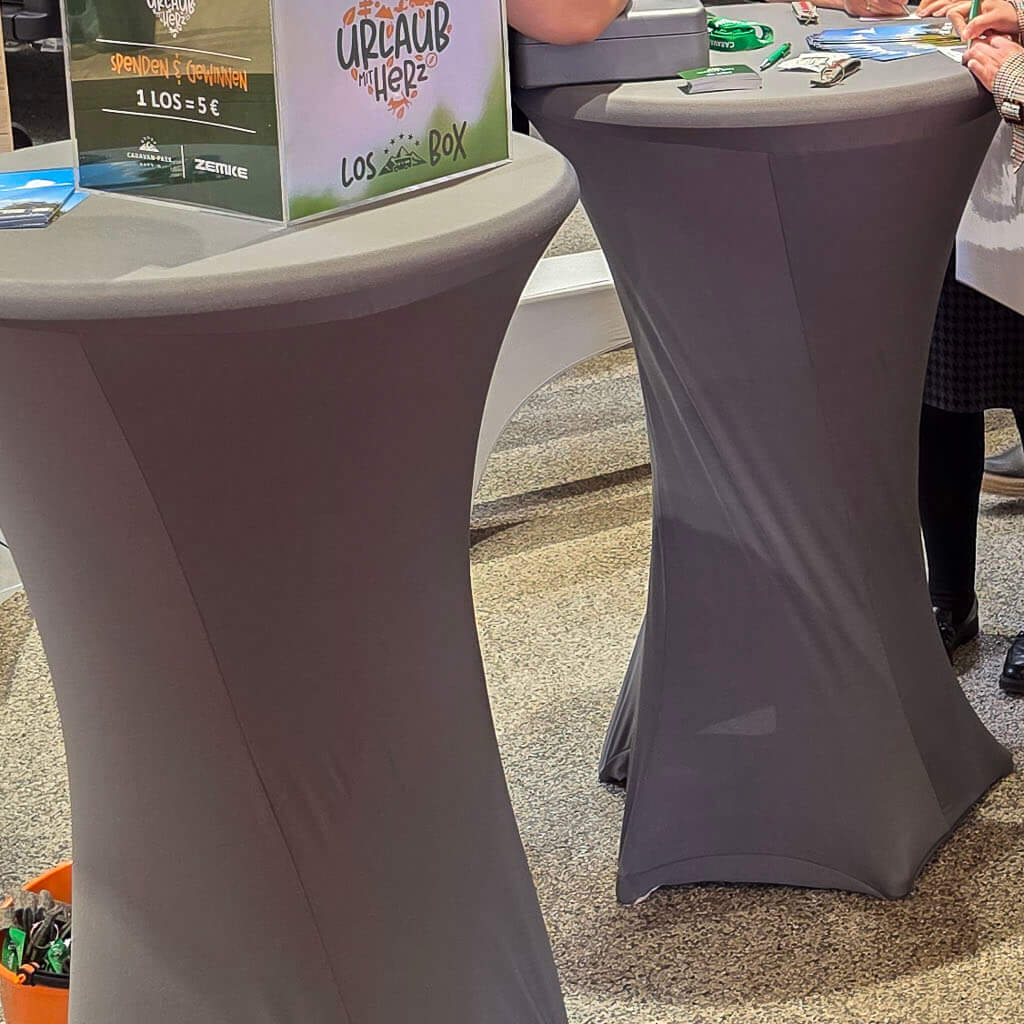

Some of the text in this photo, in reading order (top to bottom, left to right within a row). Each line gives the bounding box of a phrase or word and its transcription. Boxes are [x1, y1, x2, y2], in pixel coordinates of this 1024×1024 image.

[337, 1, 451, 70] URLAUB
[358, 69, 374, 87] MIT
[136, 88, 148, 107] 1
[150, 90, 183, 111] LOS
[197, 96, 208, 115] 5
[209, 98, 221, 117] €
[194, 158, 249, 180] ZEMKE
[341, 152, 377, 188] LOS
